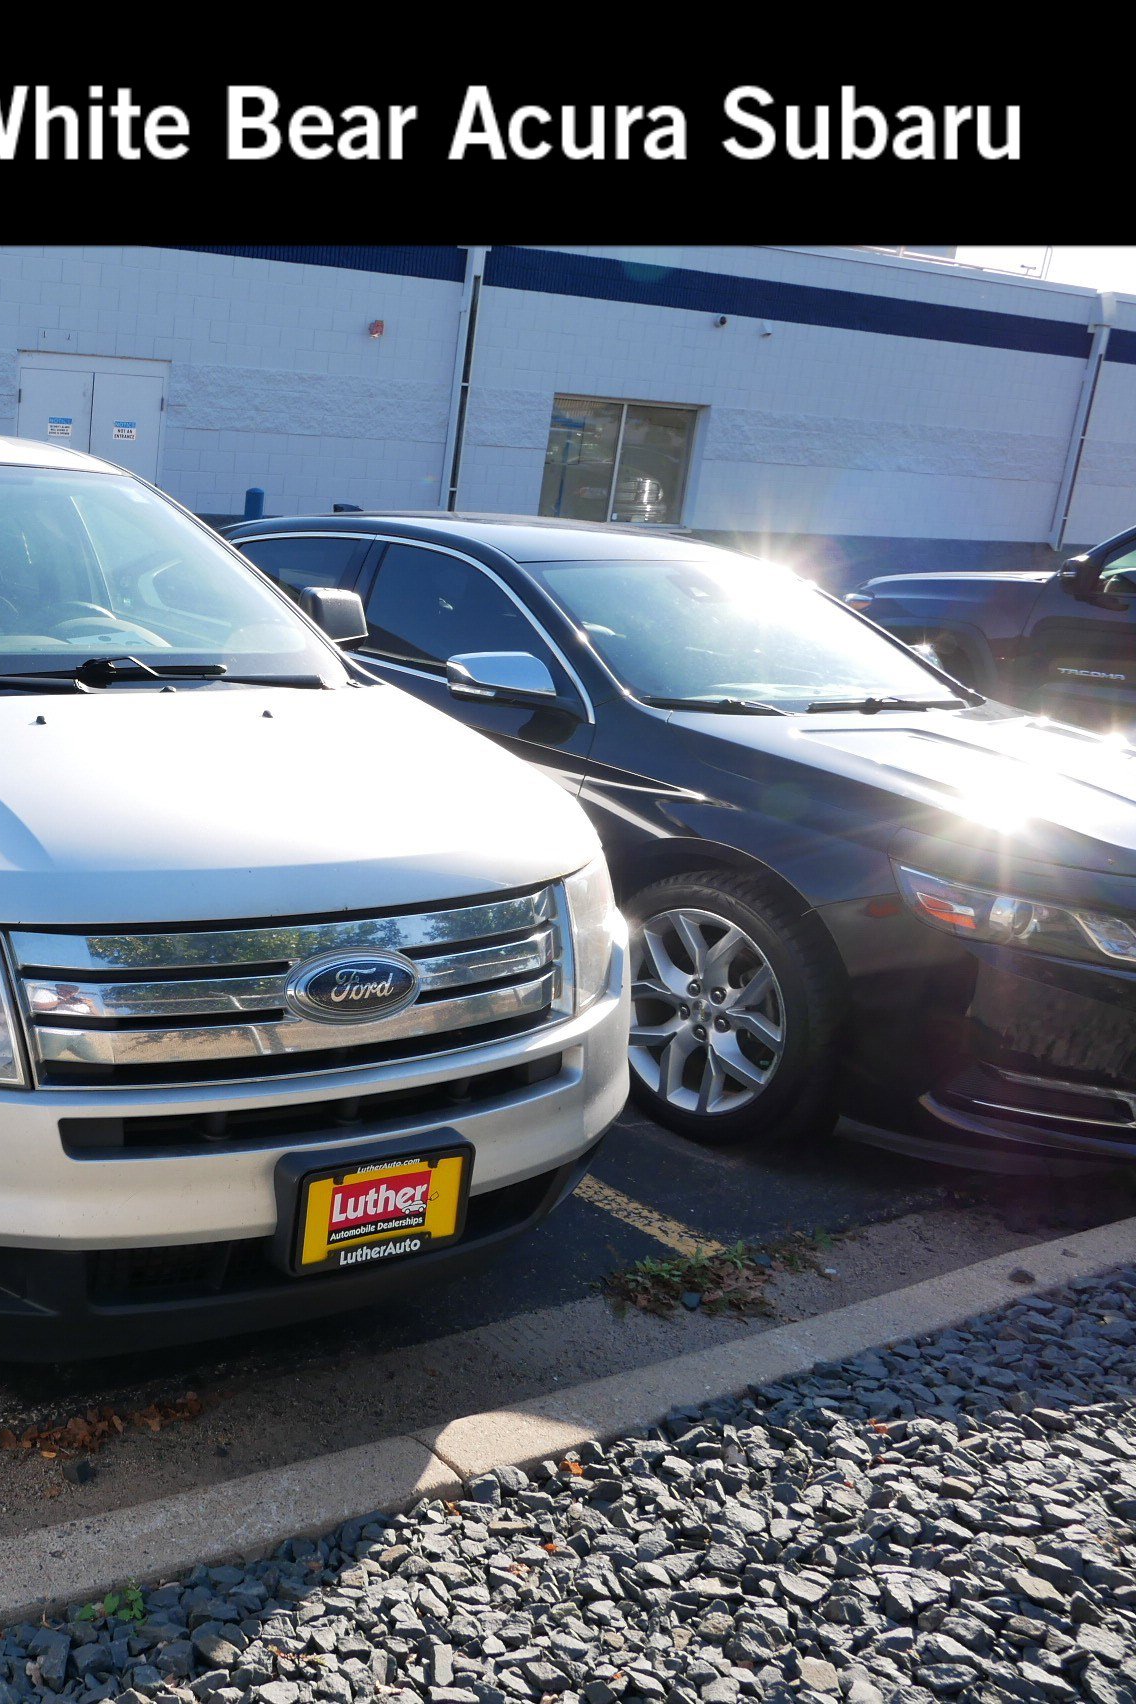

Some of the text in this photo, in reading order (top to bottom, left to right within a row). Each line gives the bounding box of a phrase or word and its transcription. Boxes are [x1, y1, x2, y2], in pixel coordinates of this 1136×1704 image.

[1057, 667, 1126, 680] TACOMA
[330, 967, 394, 1003] Ford
[357, 1158, 420, 1174] LutherAuto.com
[332, 1184, 427, 1223] Luther
[330, 1216, 423, 1241] Automobile Dealerships
[340, 1238, 421, 1265] LutherAuto
